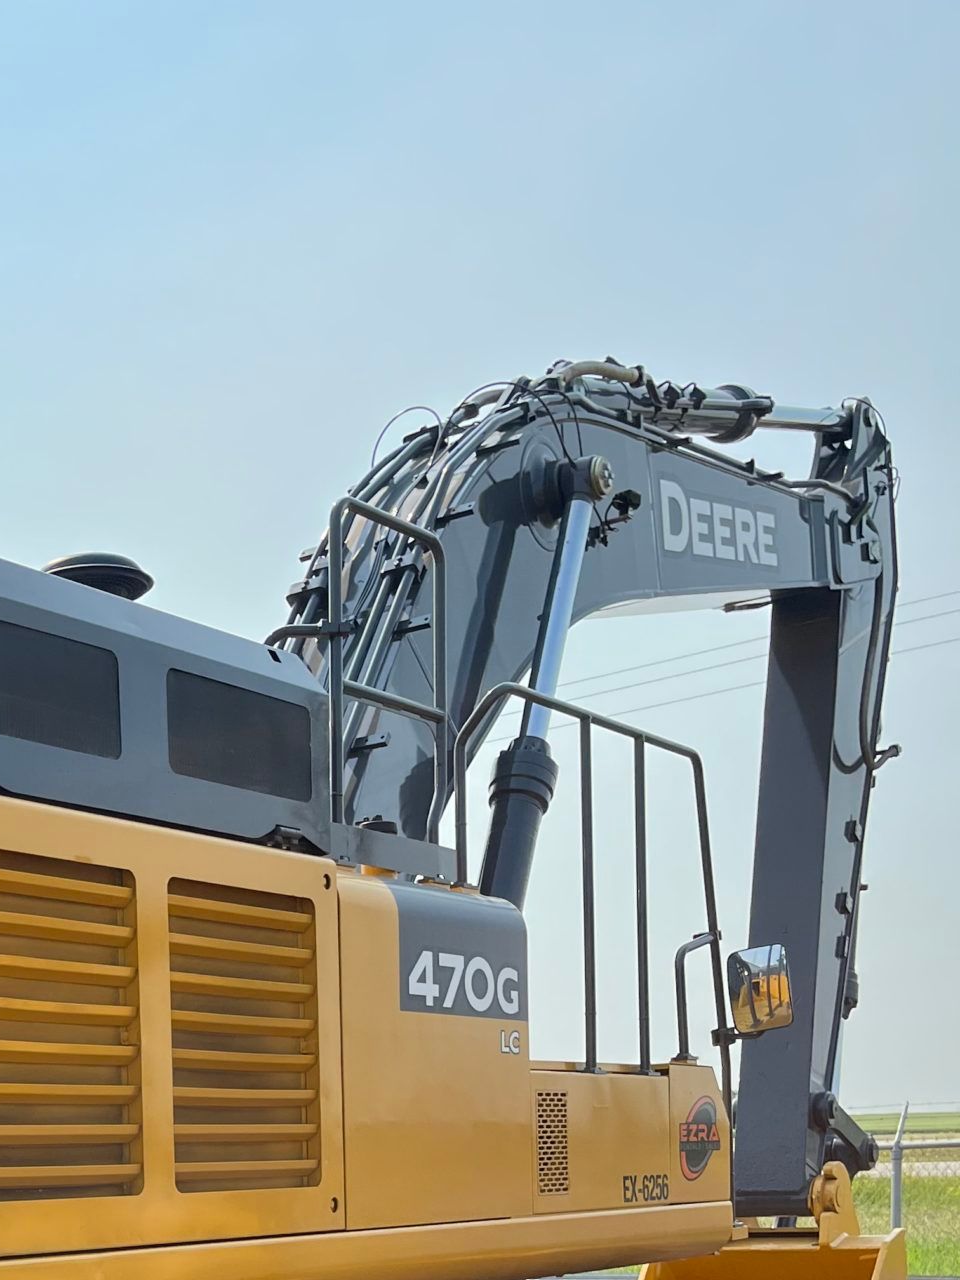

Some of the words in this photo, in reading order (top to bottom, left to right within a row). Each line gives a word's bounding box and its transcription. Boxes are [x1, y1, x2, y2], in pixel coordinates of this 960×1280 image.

[659, 479, 778, 567] DEERE
[408, 950, 520, 1015] 470G
[500, 1030, 520, 1054] LC
[680, 1123, 720, 1142] EZRA
[623, 1174, 669, 1203] EX-6256
